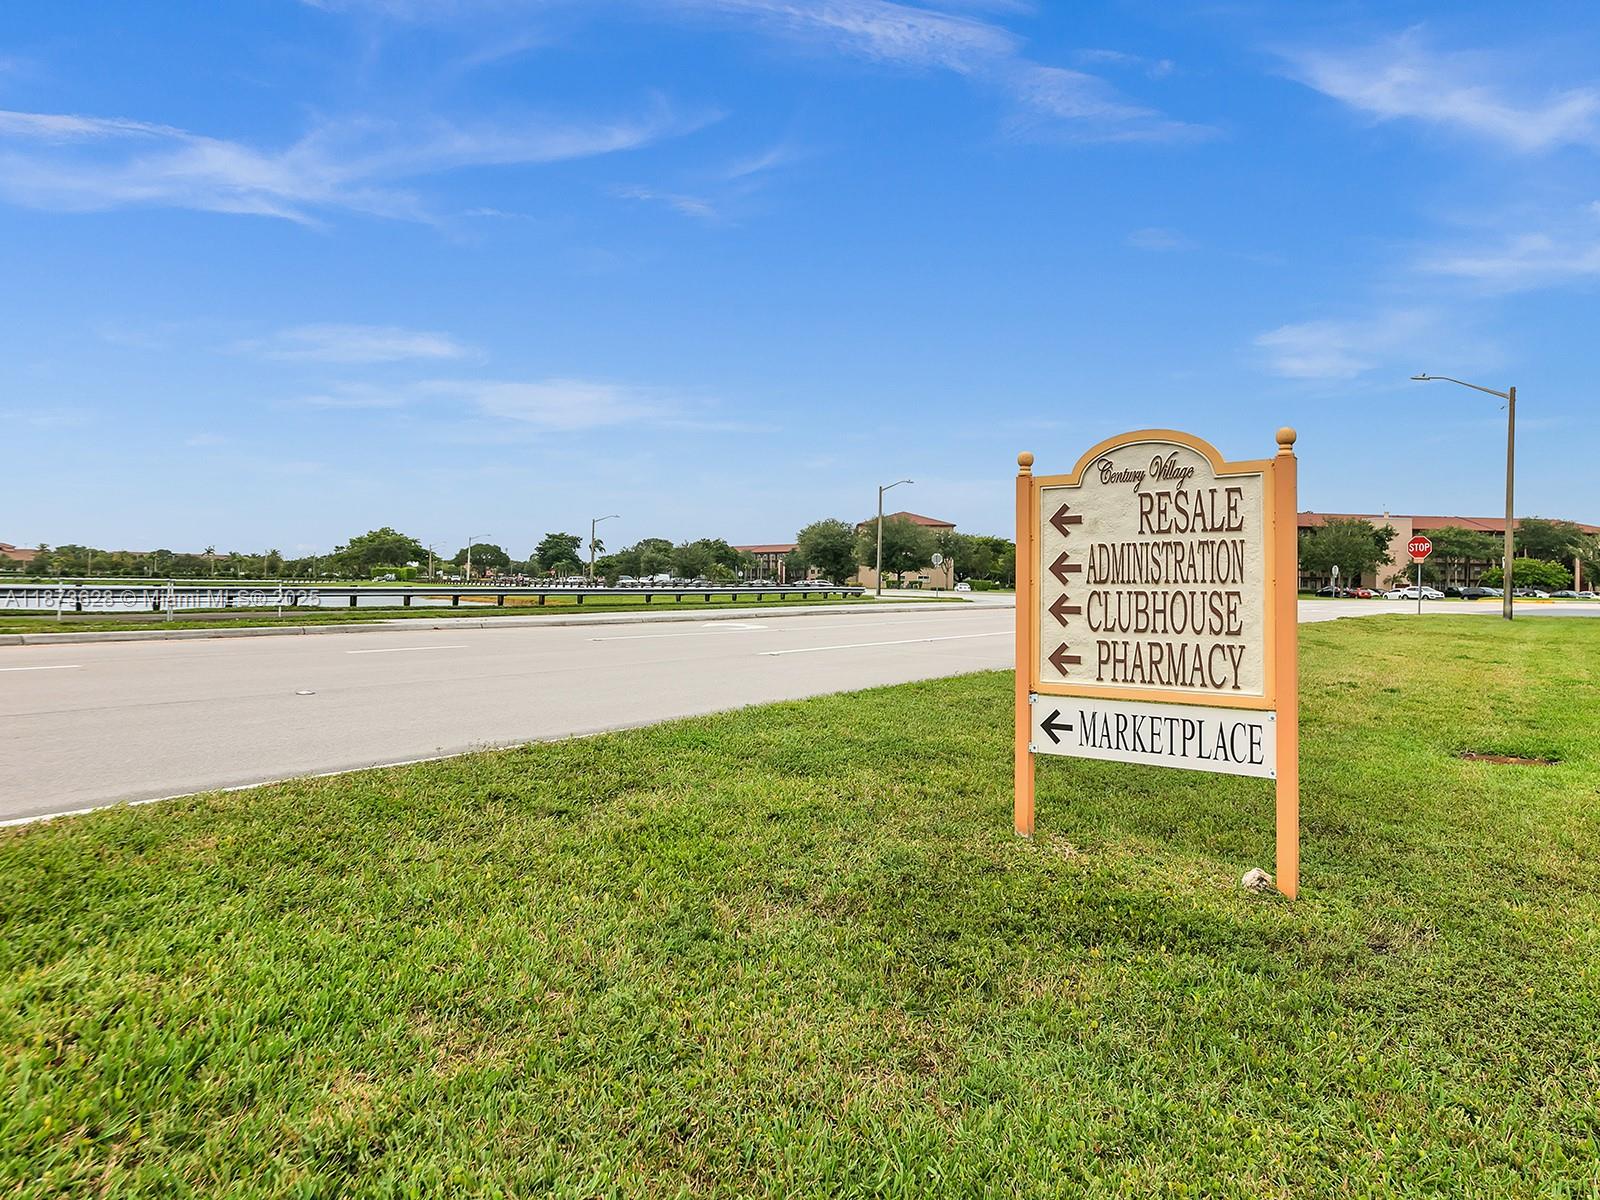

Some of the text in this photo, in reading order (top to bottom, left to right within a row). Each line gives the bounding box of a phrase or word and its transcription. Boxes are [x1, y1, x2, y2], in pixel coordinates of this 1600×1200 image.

[1097, 450, 1194, 493] Century Village
[1138, 487, 1244, 534] RESALE
[1086, 539, 1245, 584] ADMINISTRATION
[1408, 542, 1430, 552] STOP
[1086, 590, 1243, 636] CLUBHOUSE
[1096, 640, 1246, 689] PHARMACY
[1078, 710, 1265, 765] MARKETPLACE
